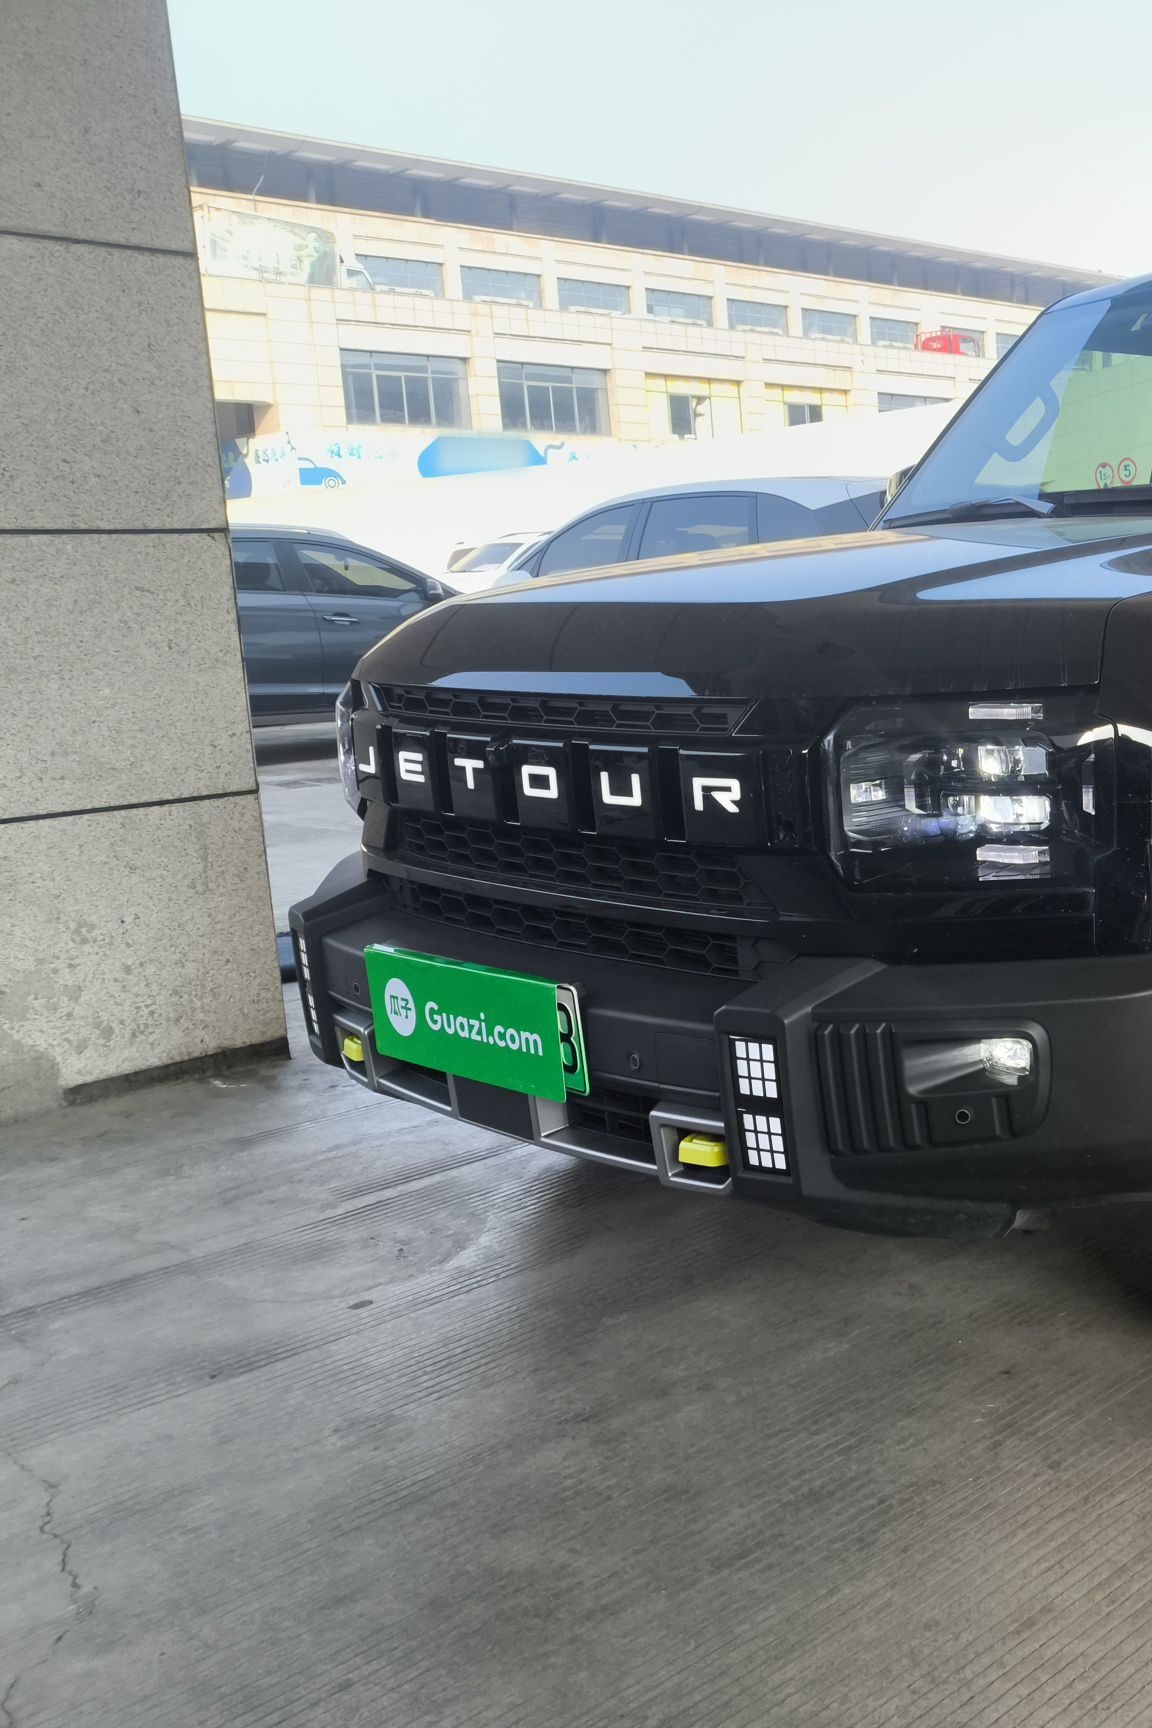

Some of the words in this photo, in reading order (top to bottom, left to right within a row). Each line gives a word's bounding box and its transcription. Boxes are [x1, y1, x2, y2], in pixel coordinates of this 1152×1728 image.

[1123, 464, 1131, 478] 5
[358, 746, 741, 813] JETOUR
[389, 994, 412, 1020] 瓜子
[424, 1000, 543, 1057] Guazi.com
